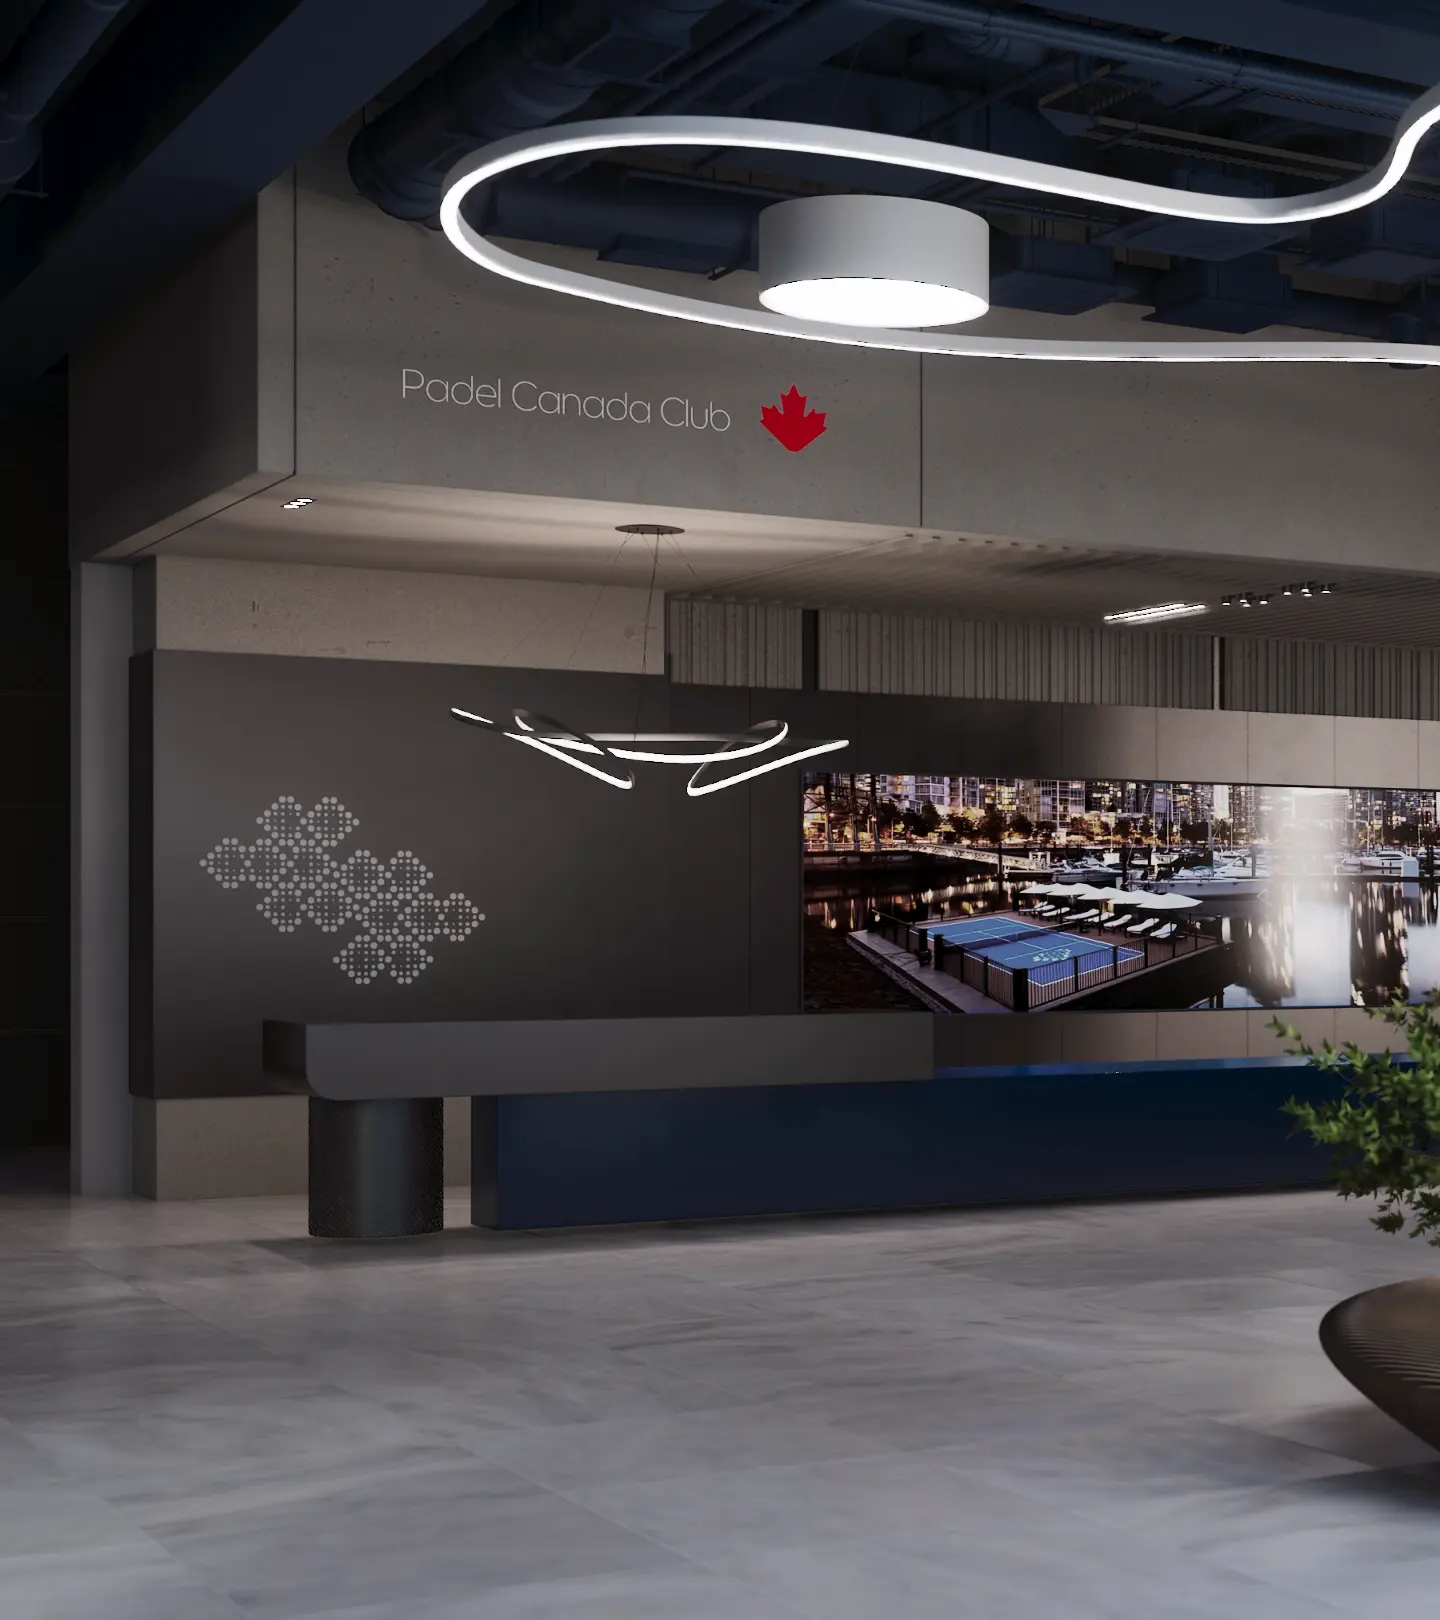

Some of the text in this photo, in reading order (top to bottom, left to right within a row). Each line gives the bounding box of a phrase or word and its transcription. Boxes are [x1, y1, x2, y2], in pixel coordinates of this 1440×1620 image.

[402, 368, 731, 432] Padel Canada Club
